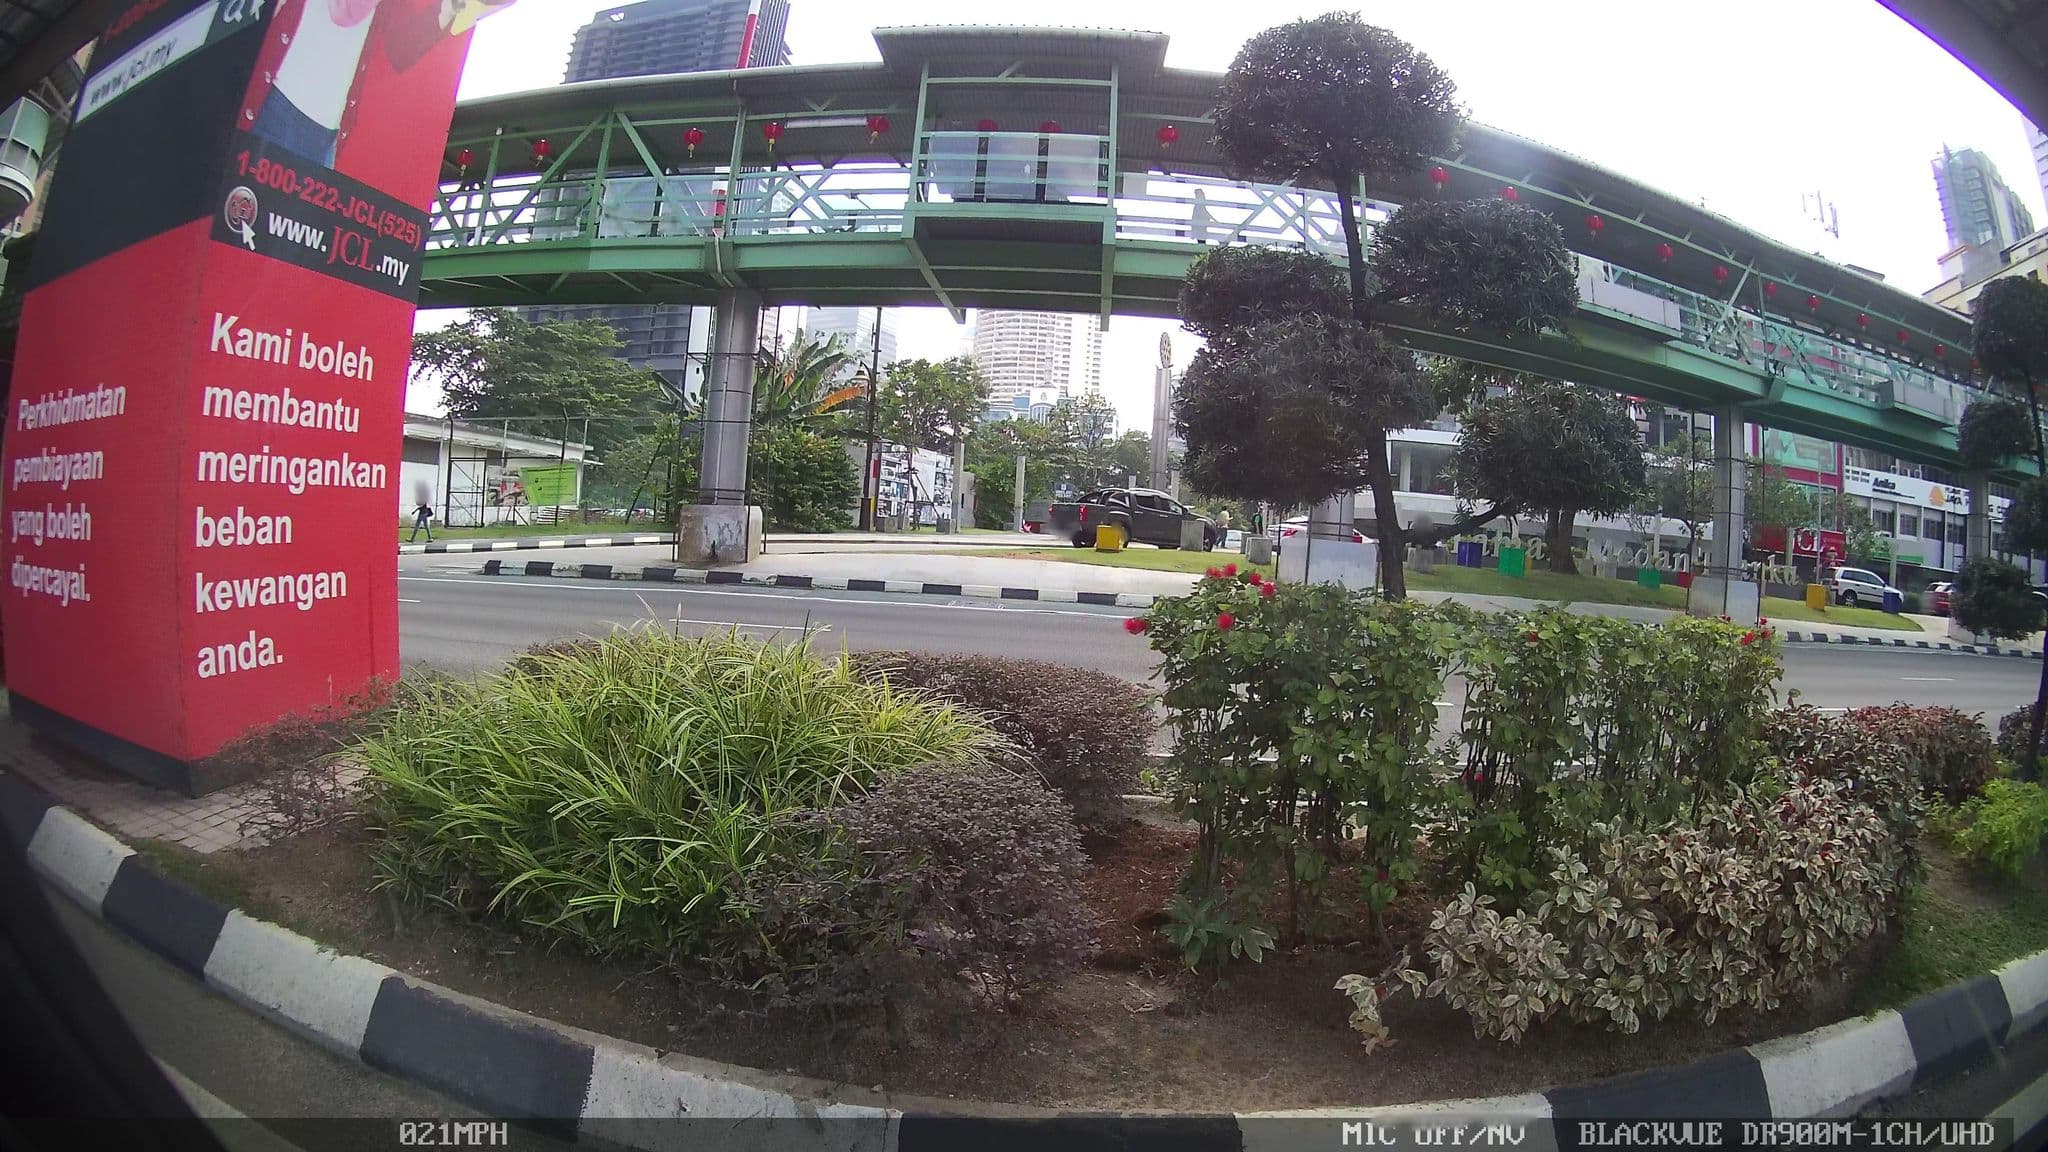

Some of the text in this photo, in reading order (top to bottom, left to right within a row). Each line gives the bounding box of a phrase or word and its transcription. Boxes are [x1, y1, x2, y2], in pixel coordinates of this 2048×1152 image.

[237, 150, 422, 251] 1-800-222-JCL(525)
[209, 312, 374, 381] Kami boleh
[17, 383, 126, 431] Perkhidmatan
[202, 386, 360, 433] membantu
[12, 446, 104, 490] pembiayaan
[198, 445, 387, 494] meringankan
[11, 503, 91, 546] yang boleh
[195, 506, 293, 547] beban
[11, 556, 91, 606] dipercayai.
[195, 570, 347, 613] kewangan
[197, 630, 284, 678] anda.
